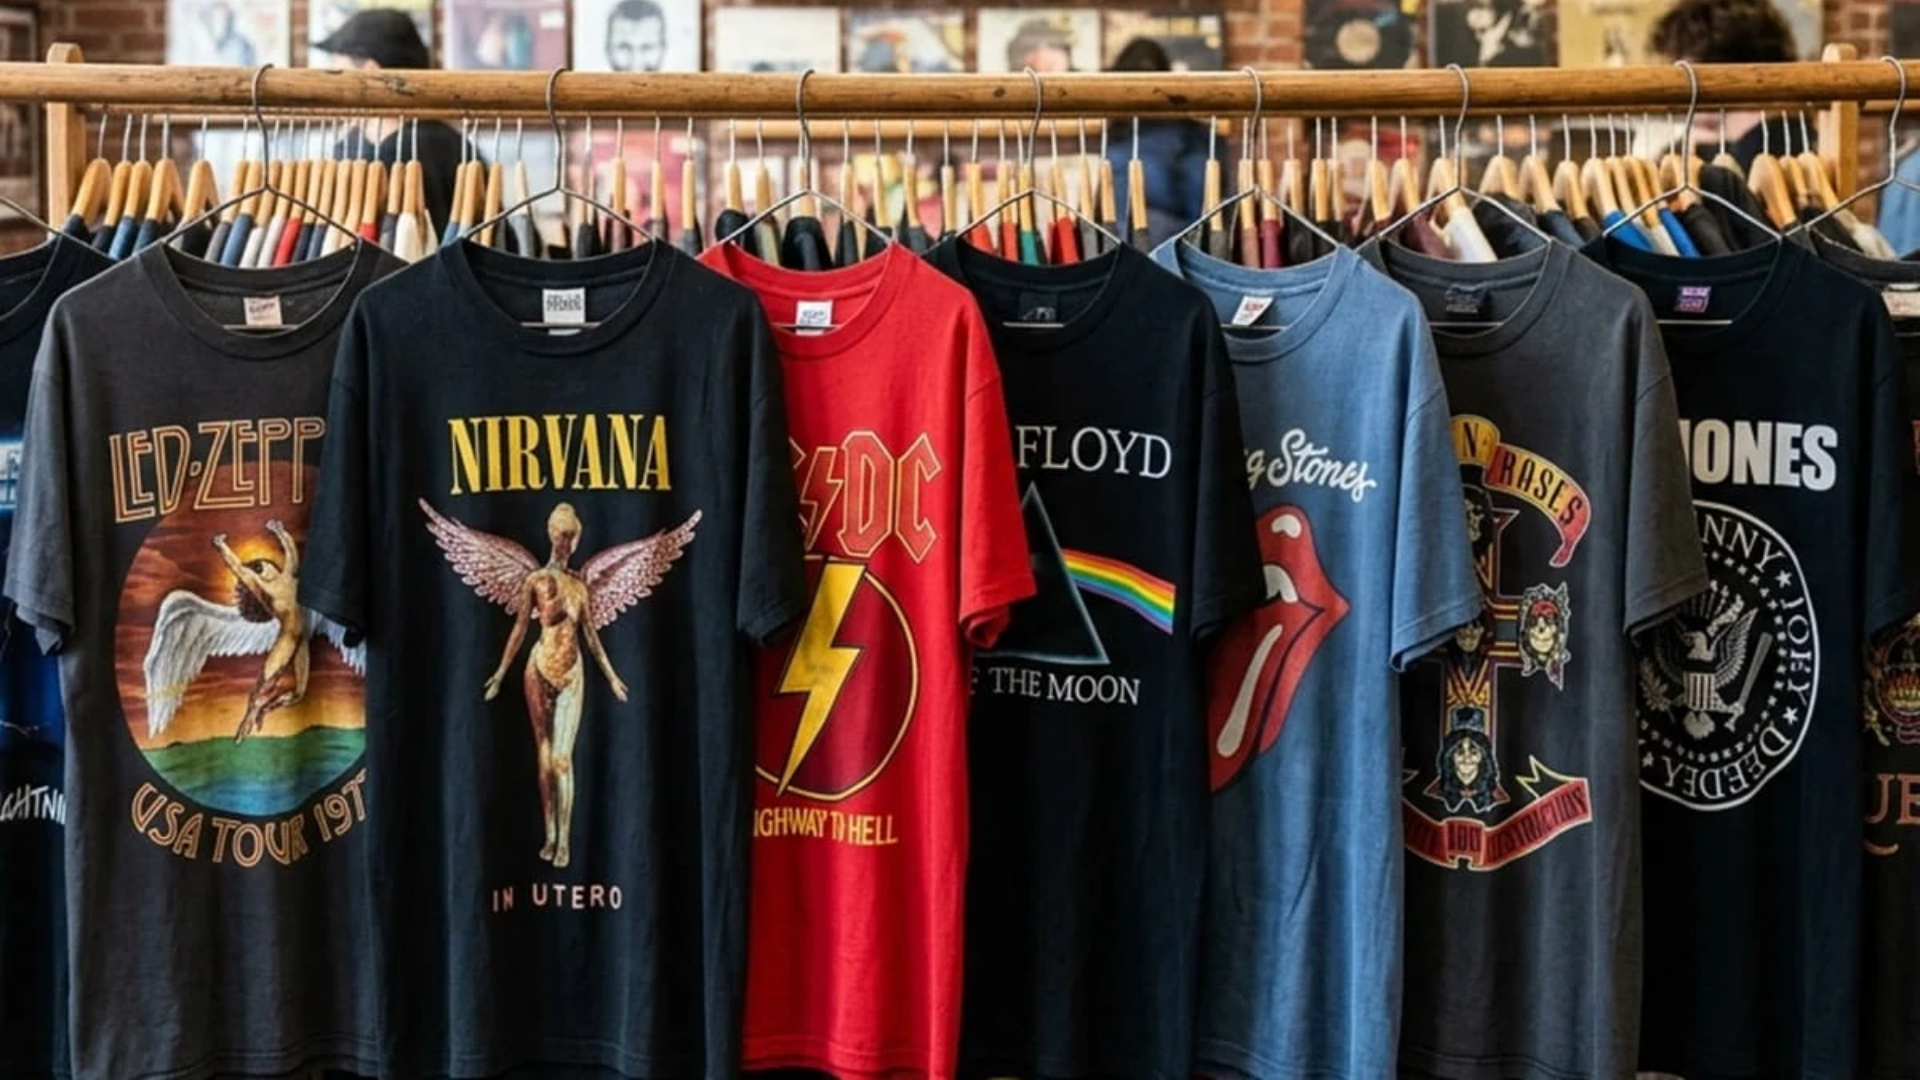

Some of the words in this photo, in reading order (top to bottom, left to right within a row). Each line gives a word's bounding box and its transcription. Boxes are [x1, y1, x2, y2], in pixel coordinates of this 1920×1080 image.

[448, 414, 671, 495] NIRVANA
[1015, 425, 1172, 479] FLOYD
[1266, 427, 1377, 502] Stones
[988, 667, 1042, 698] THE
[1046, 672, 1141, 706] MOON
[131, 782, 203, 860] USA
[212, 814, 308, 868] TOUR
[848, 814, 899, 846] HELL
[493, 886, 514, 913] IN
[532, 883, 622, 910] UTERO
